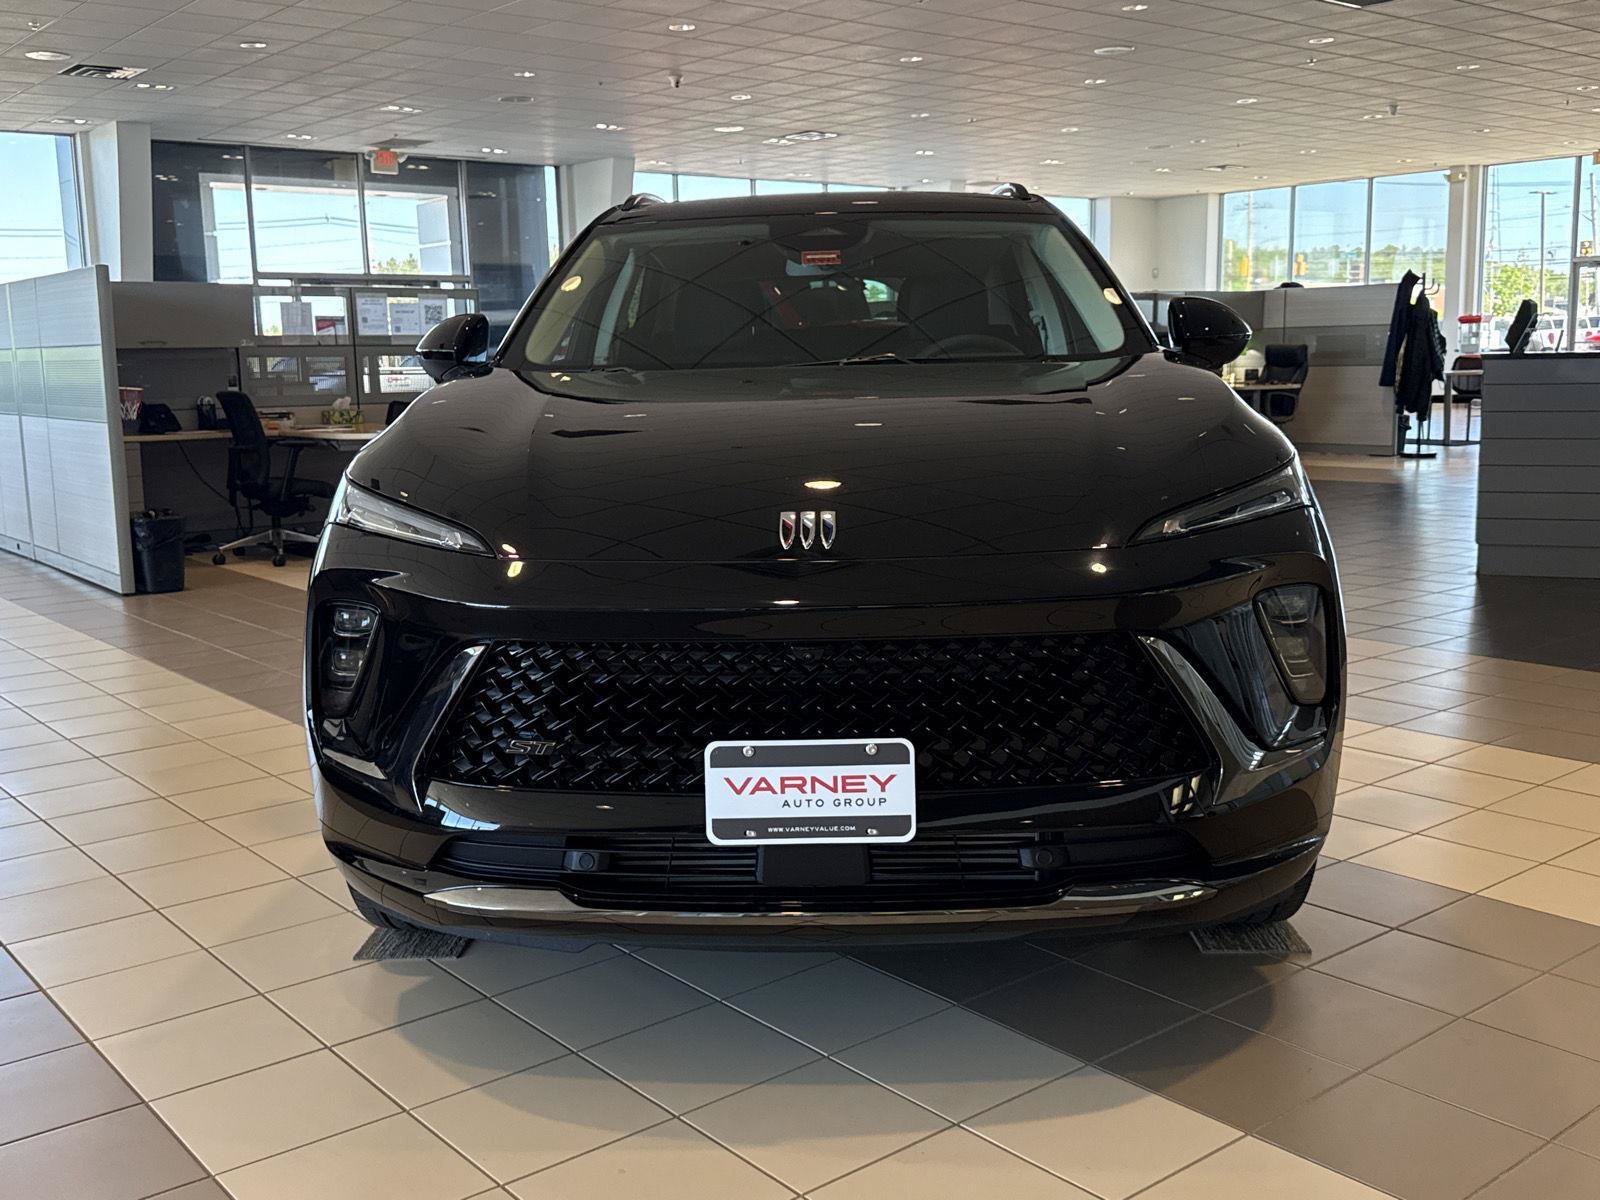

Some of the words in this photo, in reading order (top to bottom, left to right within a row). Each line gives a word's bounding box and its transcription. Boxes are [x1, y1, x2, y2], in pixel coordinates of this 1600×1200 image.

[505, 740, 556, 755] ST
[724, 774, 897, 795] VARNEY
[782, 799, 825, 808] AUTO
[833, 798, 887, 807] GROUP
[767, 825, 856, 833] WWW.VARNEYVALUE.COM
